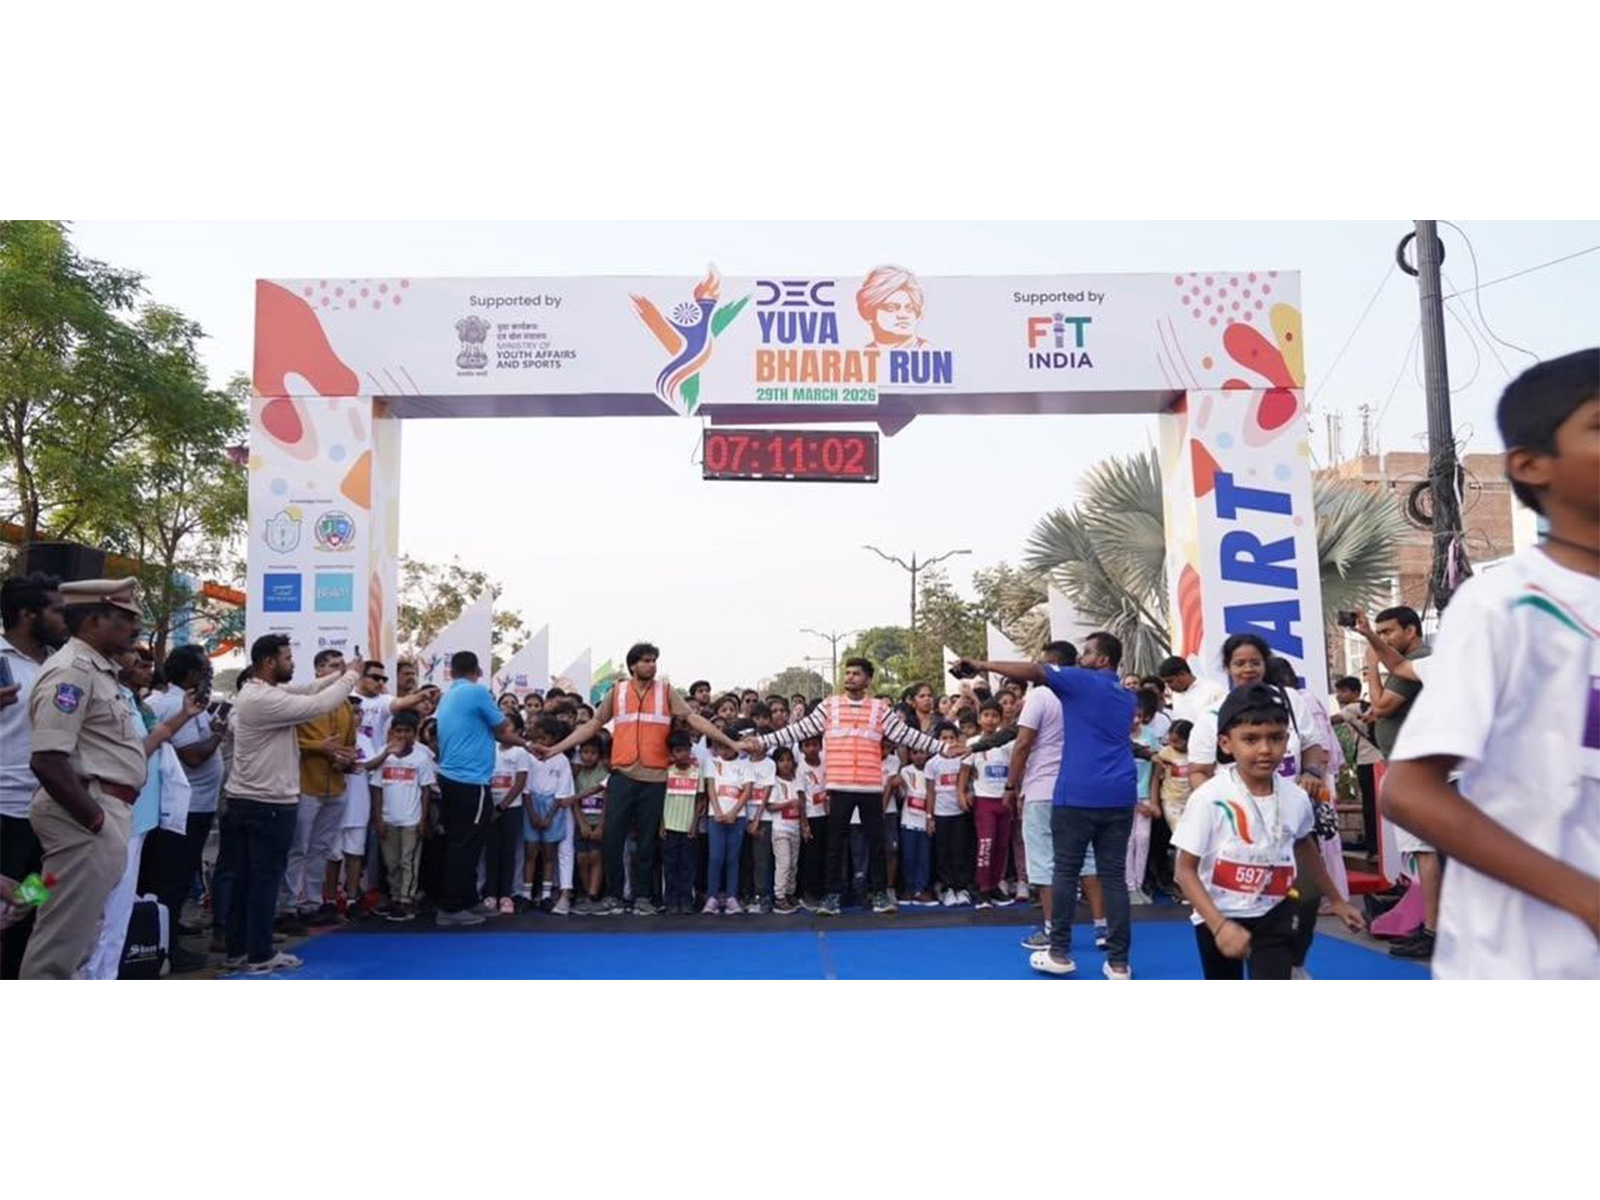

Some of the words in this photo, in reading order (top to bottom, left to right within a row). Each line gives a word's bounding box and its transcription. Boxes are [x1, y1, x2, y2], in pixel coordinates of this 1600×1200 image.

[757, 281, 834, 306] DEC
[1013, 292, 1085, 305] Supported
[1088, 291, 1105, 304] by
[469, 295, 541, 308] Supported
[545, 295, 562, 308] by
[757, 311, 839, 344] YUVA
[496, 341, 537, 350] MINISTRY
[539, 341, 551, 350] OF
[497, 350, 532, 359] YOUTH
[535, 350, 577, 359] AFFAIRS
[1029, 352, 1093, 369] INDIA
[496, 360, 520, 369] AND
[522, 360, 561, 369] SPORTS
[757, 349, 880, 383] BHARAT
[890, 351, 953, 384] RUN
[757, 388, 788, 401] 29TH
[792, 388, 838, 401] MARCH
[842, 388, 876, 401] 2026
[705, 435, 856, 474] 07:11:02
